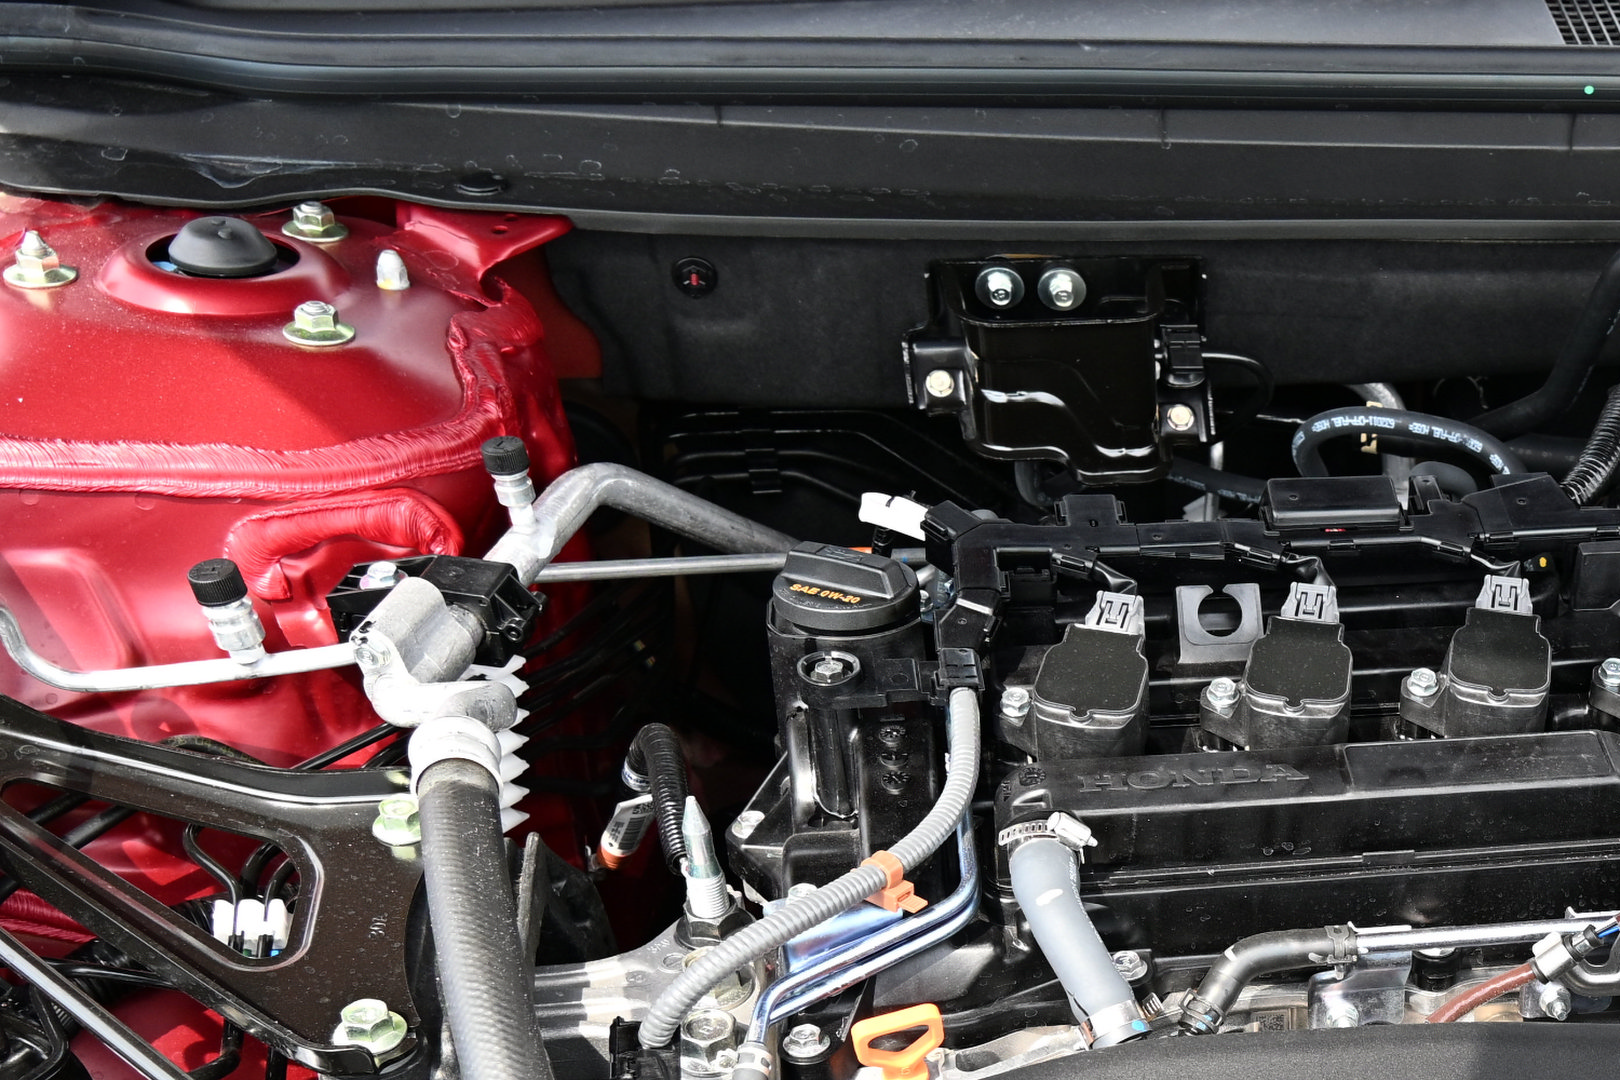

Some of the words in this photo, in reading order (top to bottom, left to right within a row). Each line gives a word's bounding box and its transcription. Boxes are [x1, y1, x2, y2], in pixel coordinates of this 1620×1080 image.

[789, 583, 822, 596] SAE
[820, 588, 861, 605] 0W-20
[1079, 764, 1310, 793] HONDA
